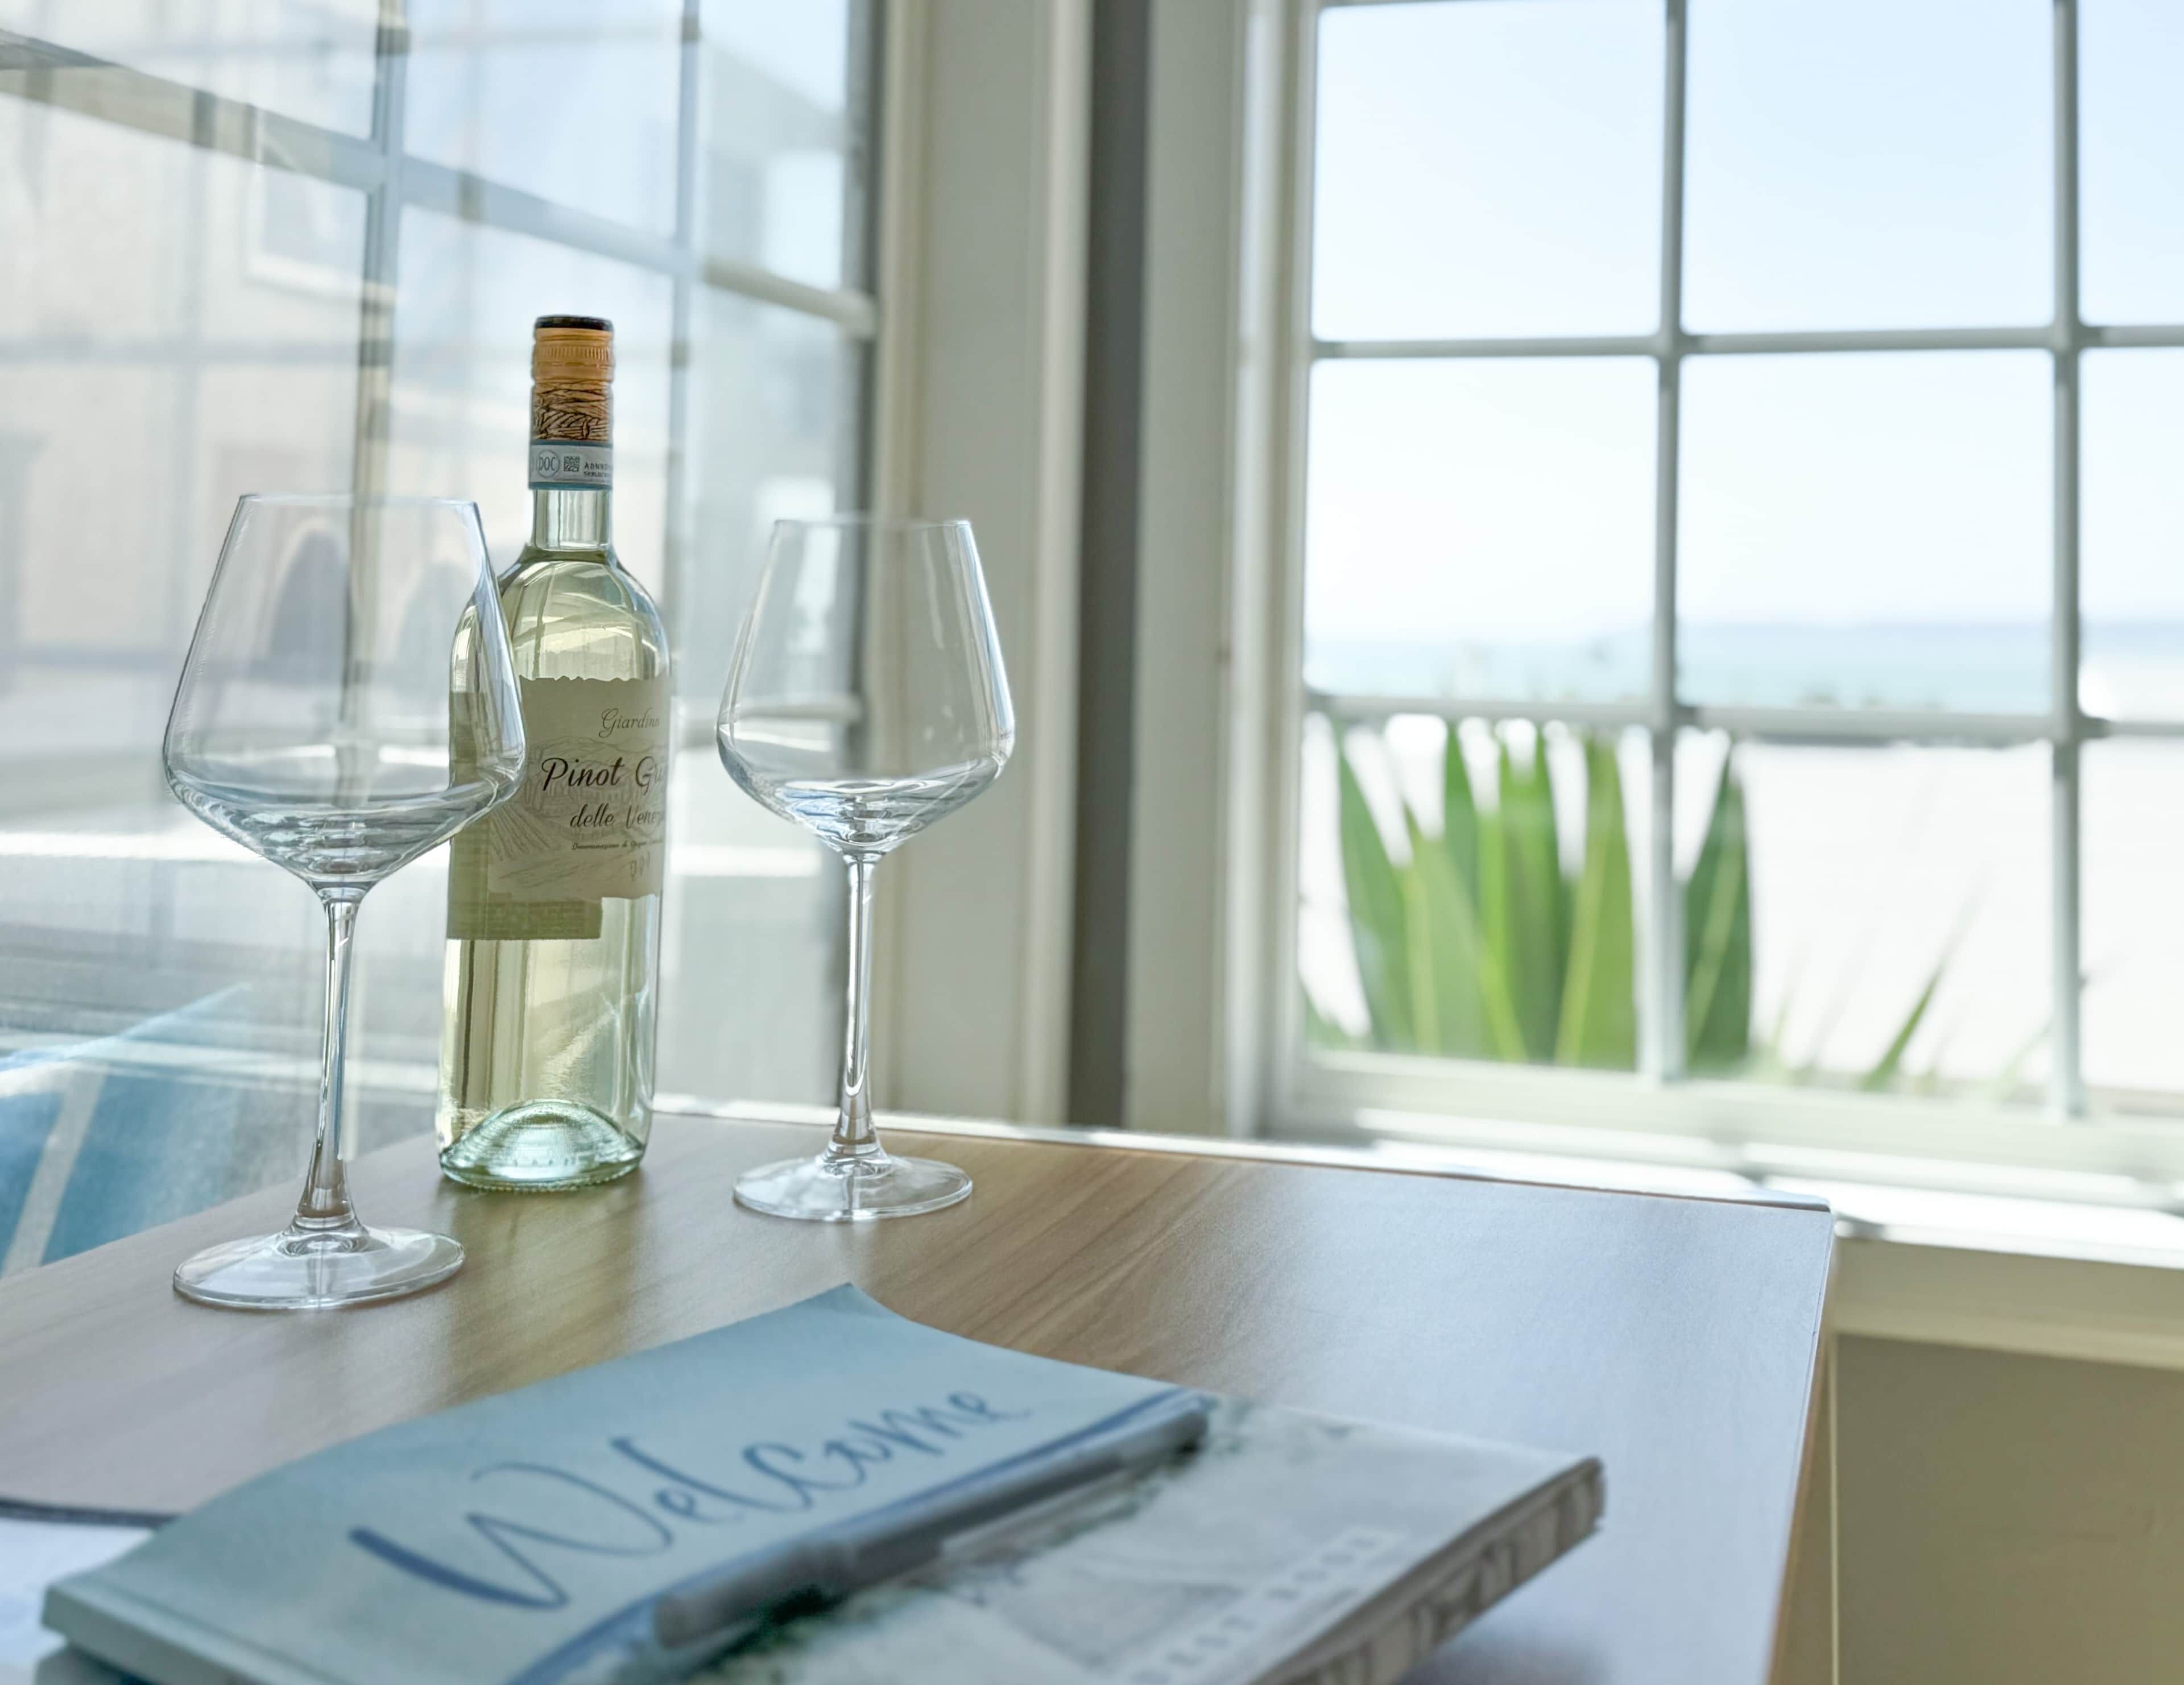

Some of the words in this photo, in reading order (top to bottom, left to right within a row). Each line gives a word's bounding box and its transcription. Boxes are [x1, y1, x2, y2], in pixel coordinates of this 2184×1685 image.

[539, 456, 556, 471] DOC
[541, 757, 625, 791] Pinot
[570, 802, 615, 827] delle
